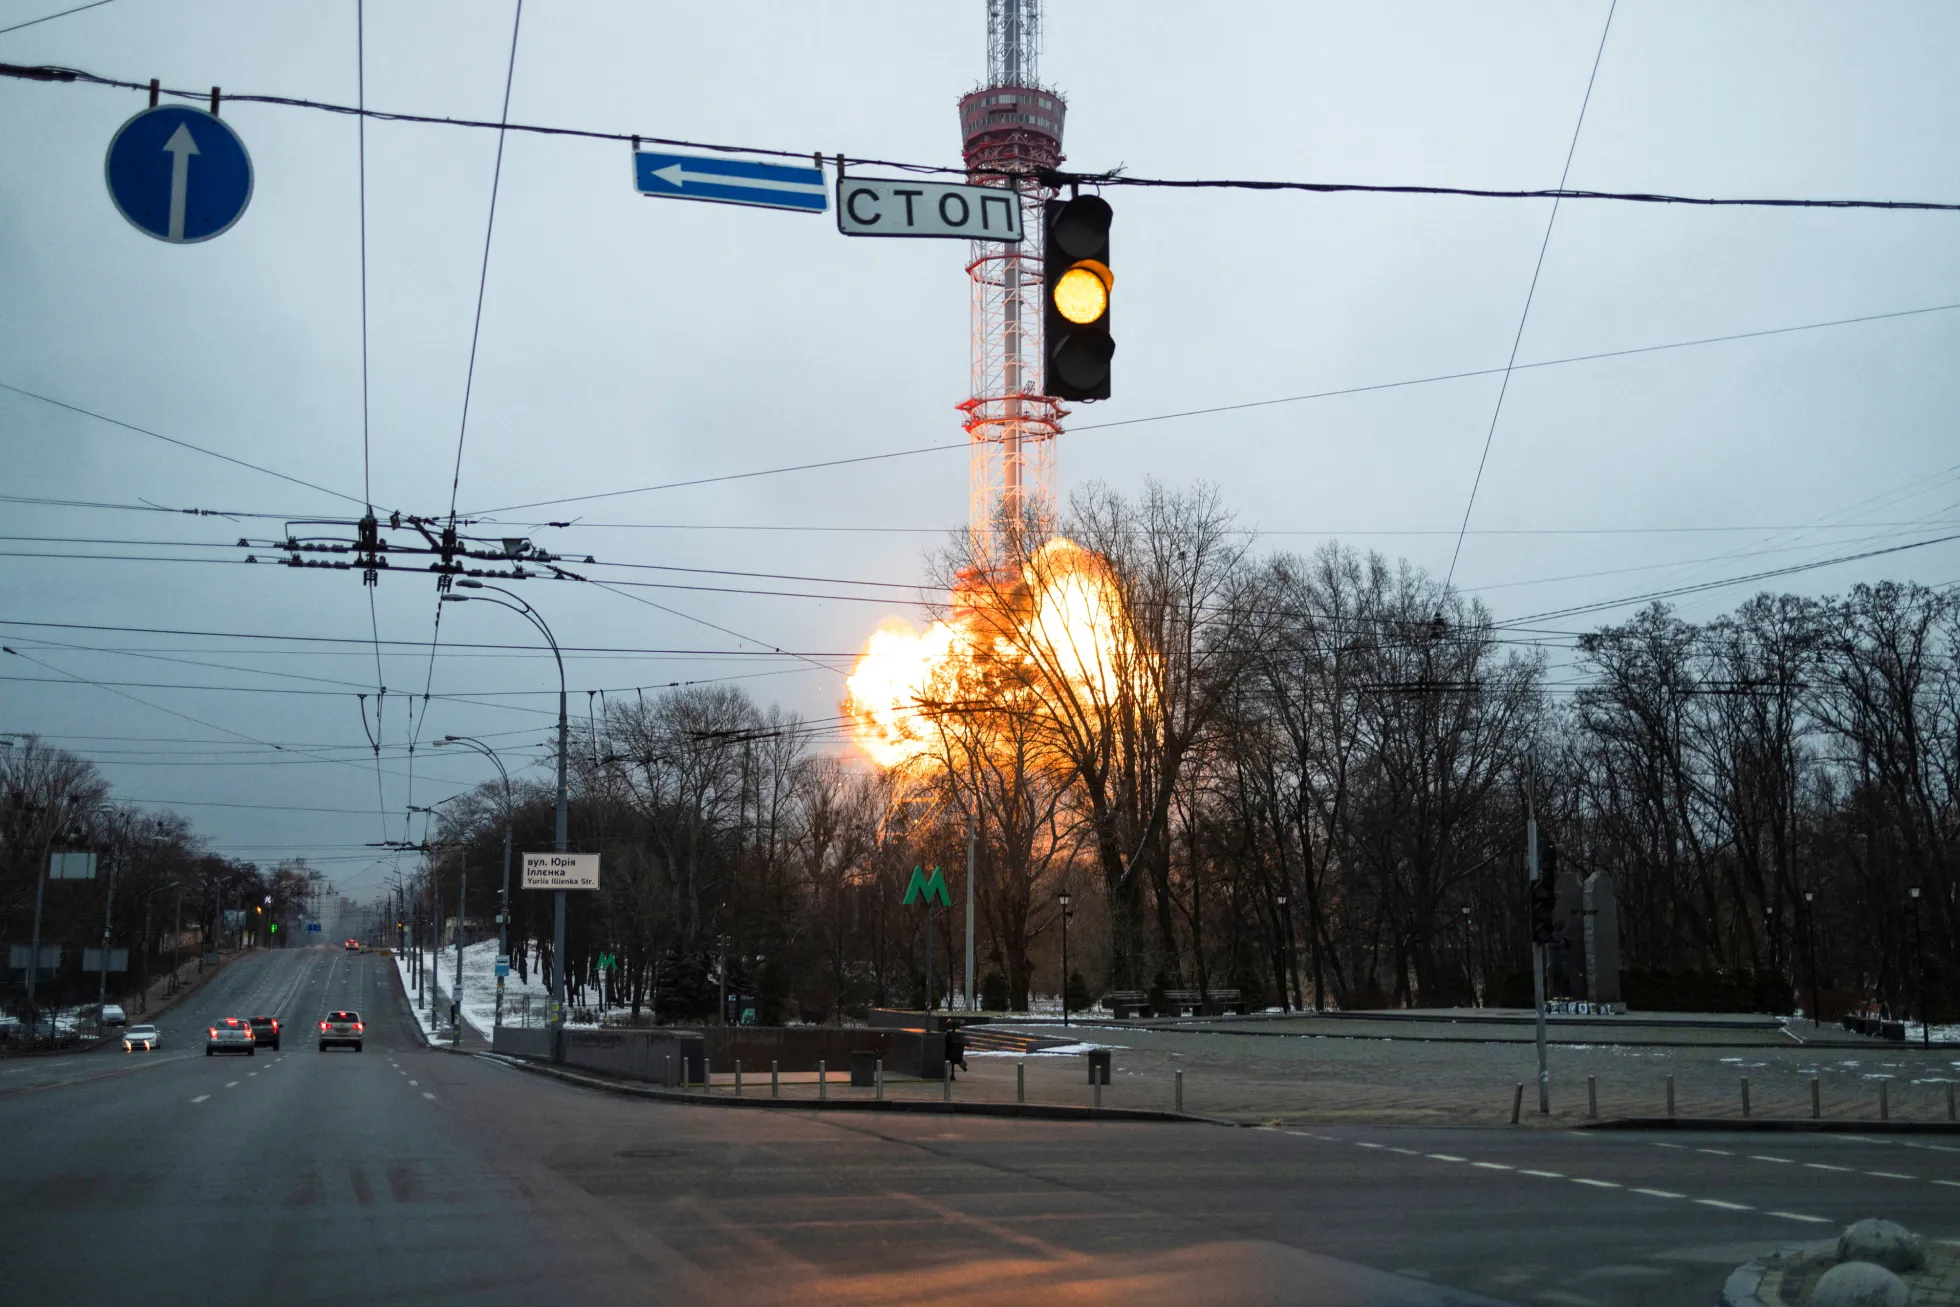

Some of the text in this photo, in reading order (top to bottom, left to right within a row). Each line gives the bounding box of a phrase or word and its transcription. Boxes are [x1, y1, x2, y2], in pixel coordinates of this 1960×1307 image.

[847, 188, 1013, 232] СТОП
[527, 857, 576, 867] вул. Юрія
[527, 868, 566, 877] Іллєнка
